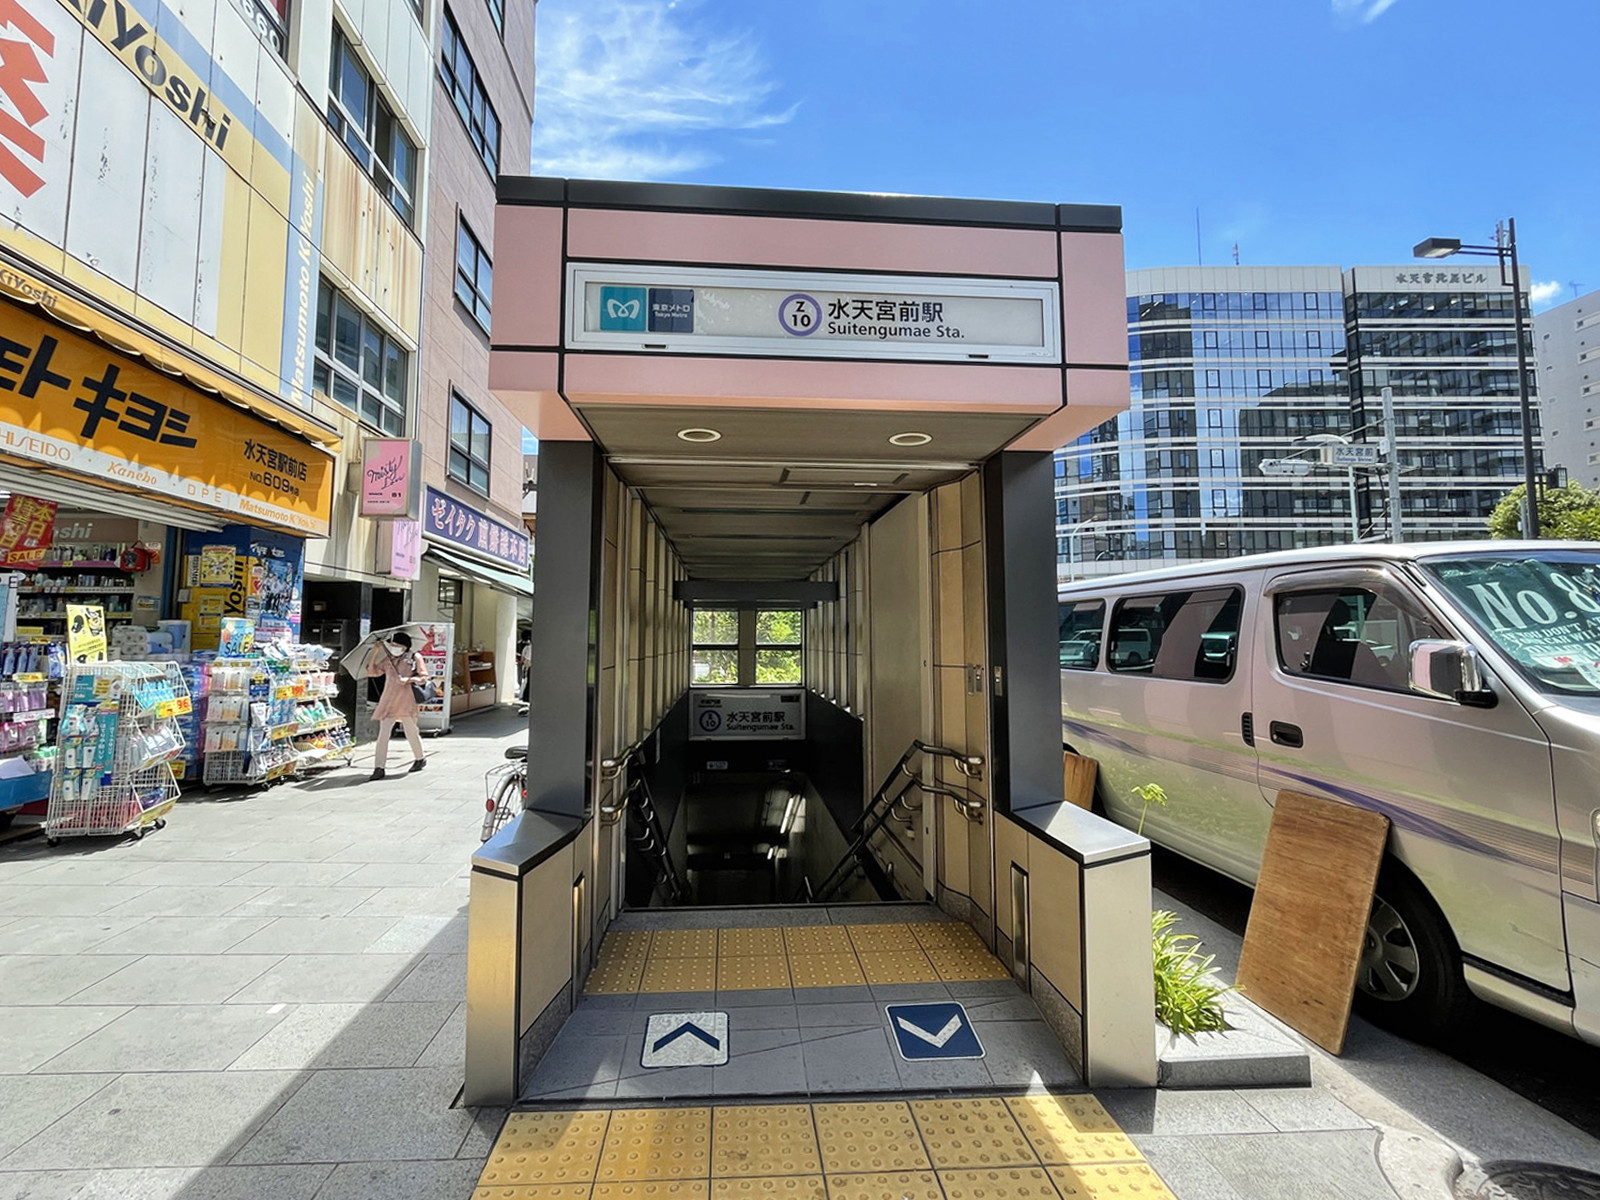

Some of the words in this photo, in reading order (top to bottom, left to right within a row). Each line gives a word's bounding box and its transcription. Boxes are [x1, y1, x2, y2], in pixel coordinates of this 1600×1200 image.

[653, 304, 690, 313] 東京メトロ
[796, 301, 805, 312] Z
[828, 298, 943, 323] 水天宮前駅
[791, 314, 811, 327] 10
[290, 267, 311, 407] Matsumoto
[828, 322, 931, 340] Suitengumae
[936, 327, 965, 339] Sta.
[244, 439, 308, 482] 水天宮駅前店
[106, 461, 157, 486] Kanebo
[239, 498, 289, 521] Matsumoto
[726, 711, 785, 722] 水天宮前駅
